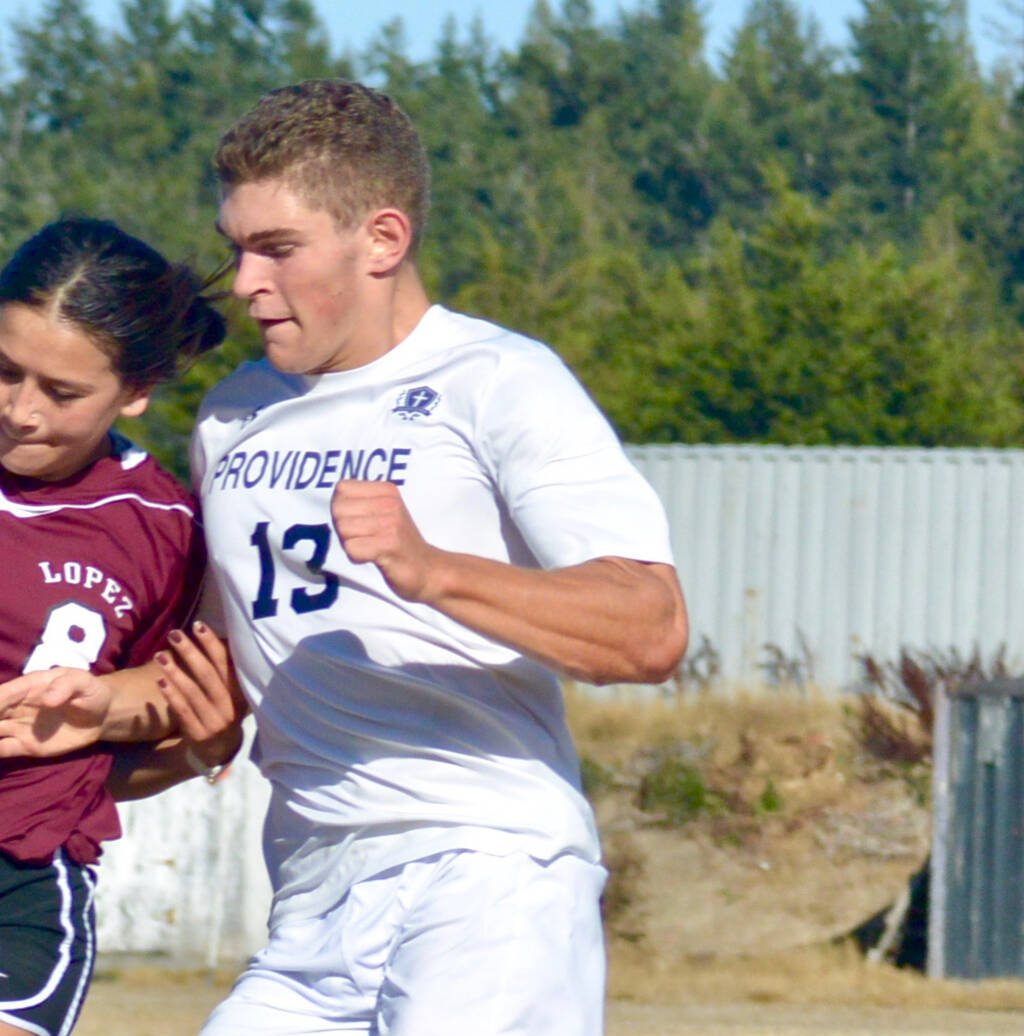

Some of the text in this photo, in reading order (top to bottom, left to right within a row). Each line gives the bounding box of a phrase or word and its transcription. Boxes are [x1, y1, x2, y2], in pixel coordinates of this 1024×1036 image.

[208, 448, 411, 493] PROVIDENCE
[38, 561, 133, 619] LOPEZ
[250, 521, 340, 620] 13
[22, 602, 107, 675] 8
